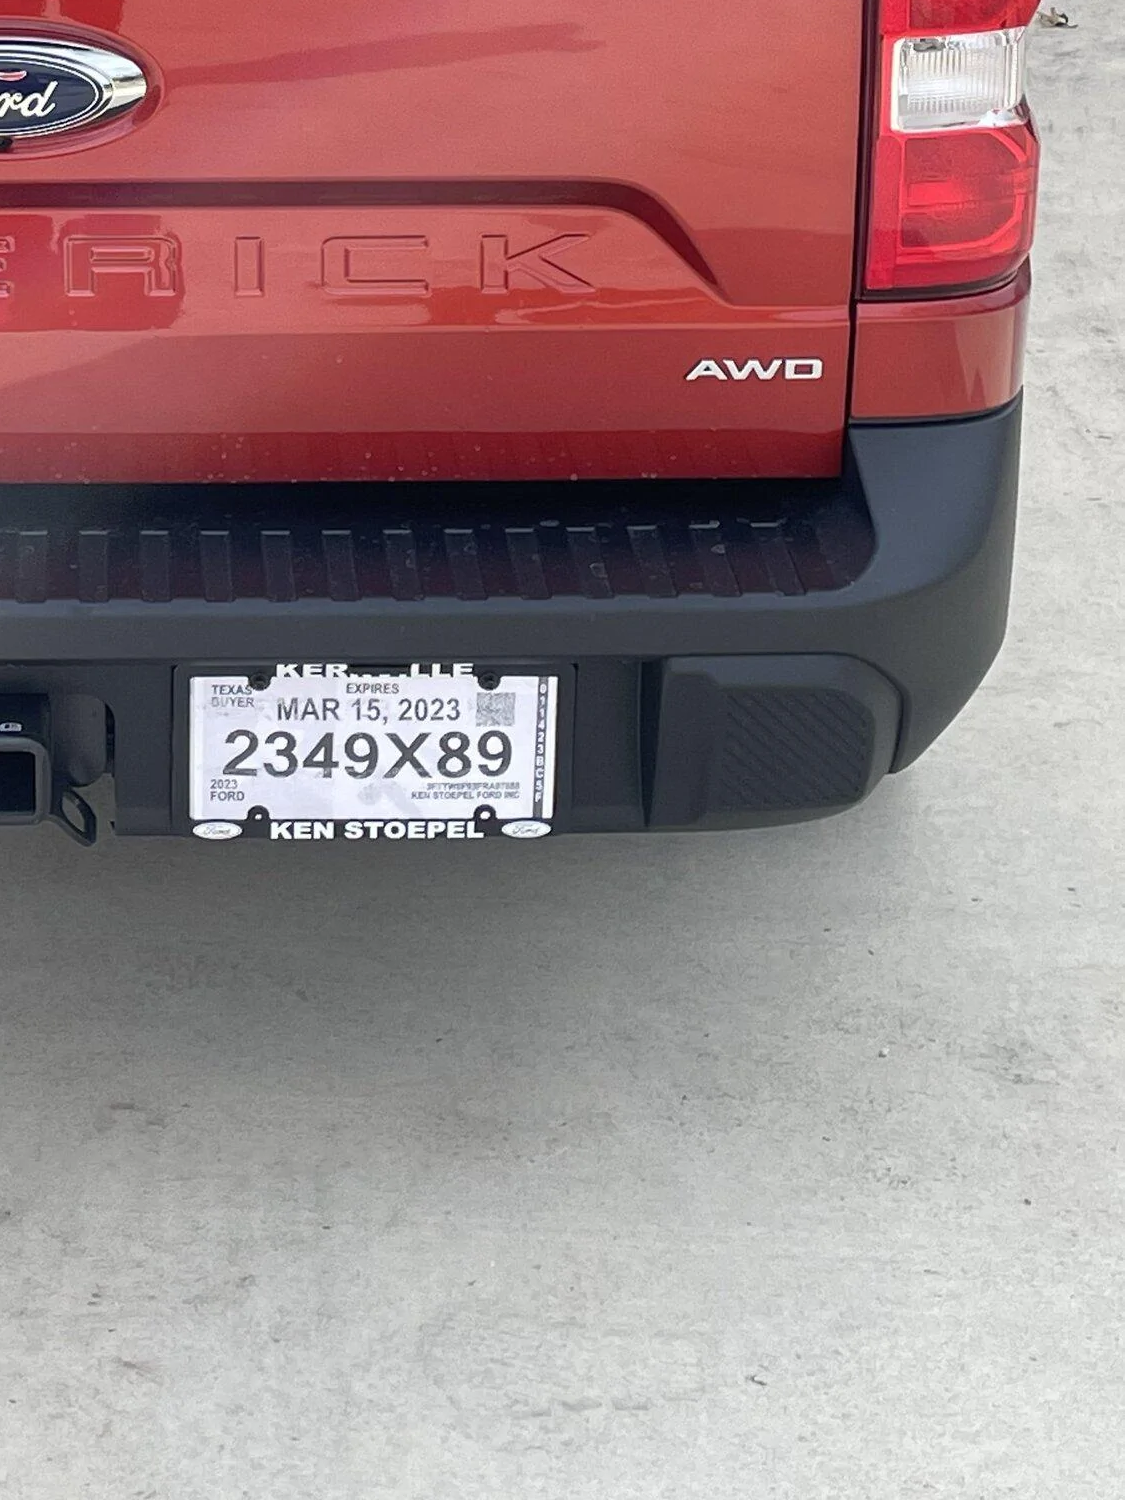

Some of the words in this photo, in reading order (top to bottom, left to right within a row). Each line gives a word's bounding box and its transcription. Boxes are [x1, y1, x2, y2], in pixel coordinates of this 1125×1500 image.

[686, 358, 823, 381] AWD
[211, 684, 253, 696] TEXAS
[346, 683, 400, 695] EXPIRES
[277, 698, 340, 721] MAR
[351, 698, 388, 725] 15,
[398, 698, 461, 721] 2023
[222, 729, 513, 779] 2349X89
[210, 779, 238, 790] 2023
[210, 791, 245, 801] FORD
[271, 822, 334, 840] KEN
[344, 821, 484, 839] STOEPEL
